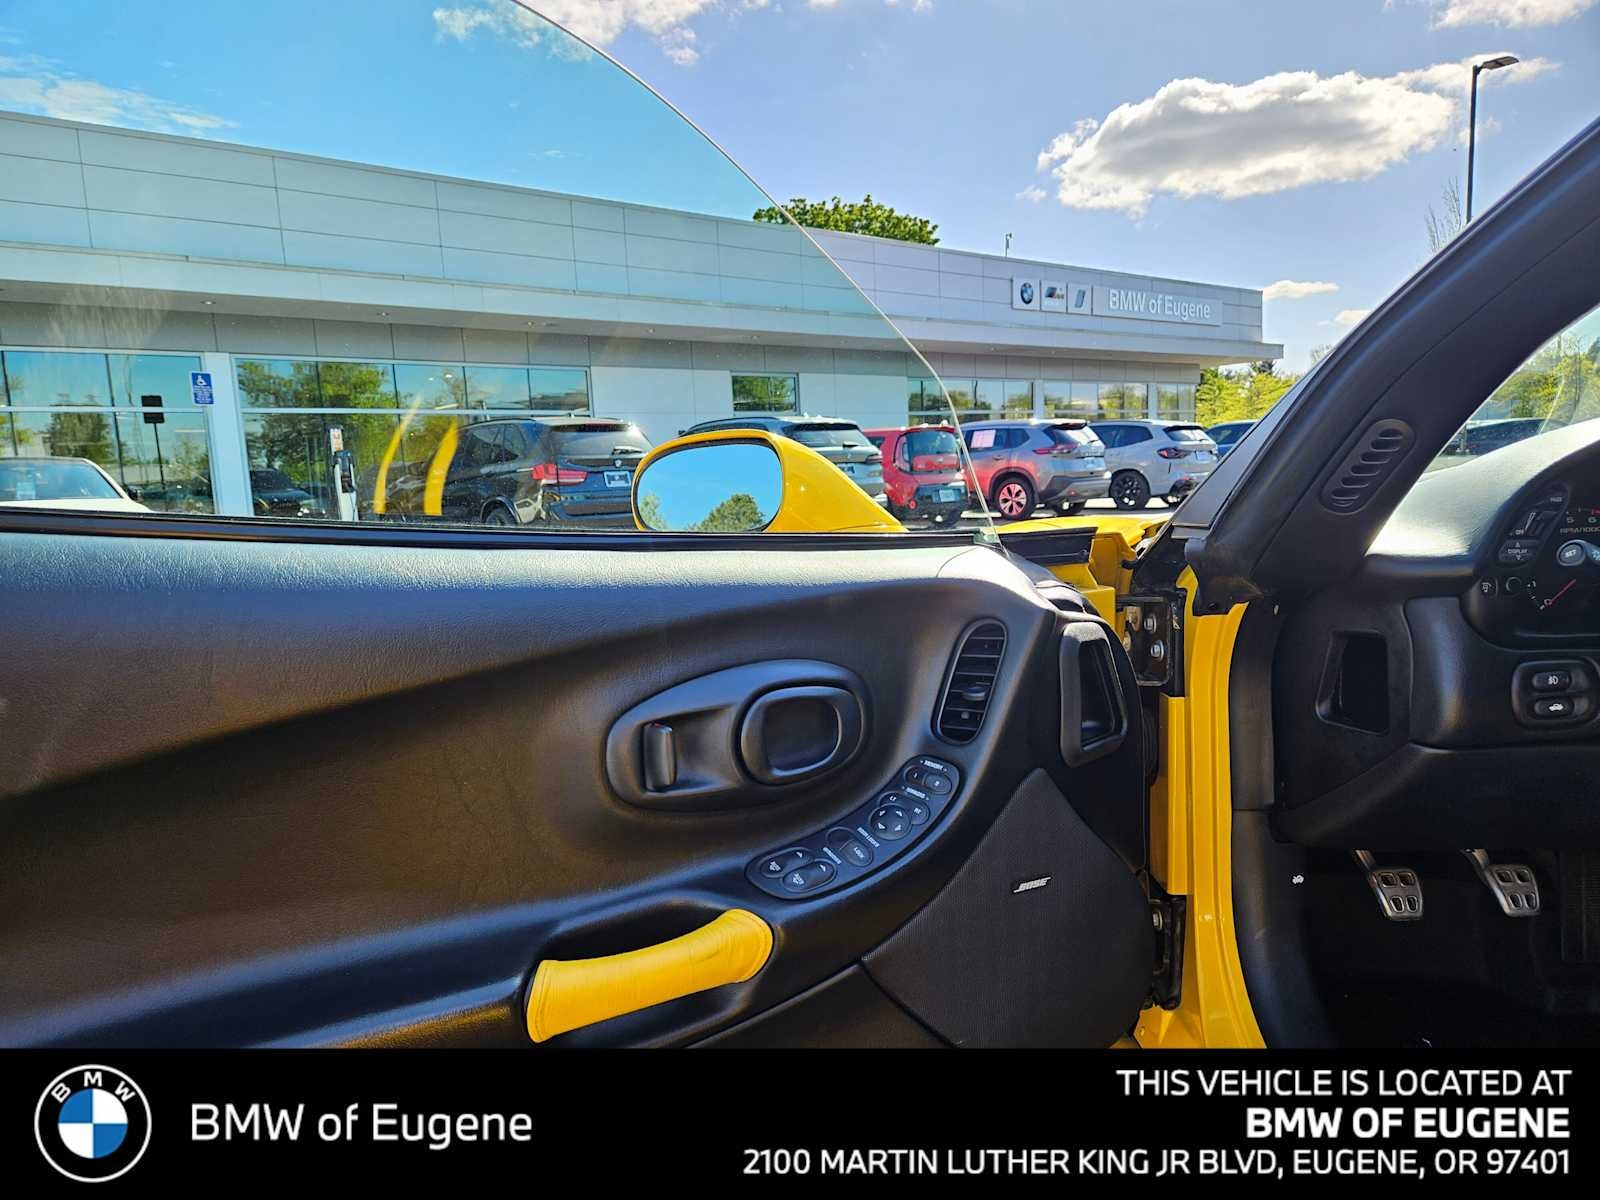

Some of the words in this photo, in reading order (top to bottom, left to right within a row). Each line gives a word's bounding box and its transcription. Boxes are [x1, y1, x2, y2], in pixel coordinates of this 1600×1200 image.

[1109, 288, 1146, 312] BMW
[1148, 294, 1163, 314] of
[1164, 295, 1211, 321] Eugene
